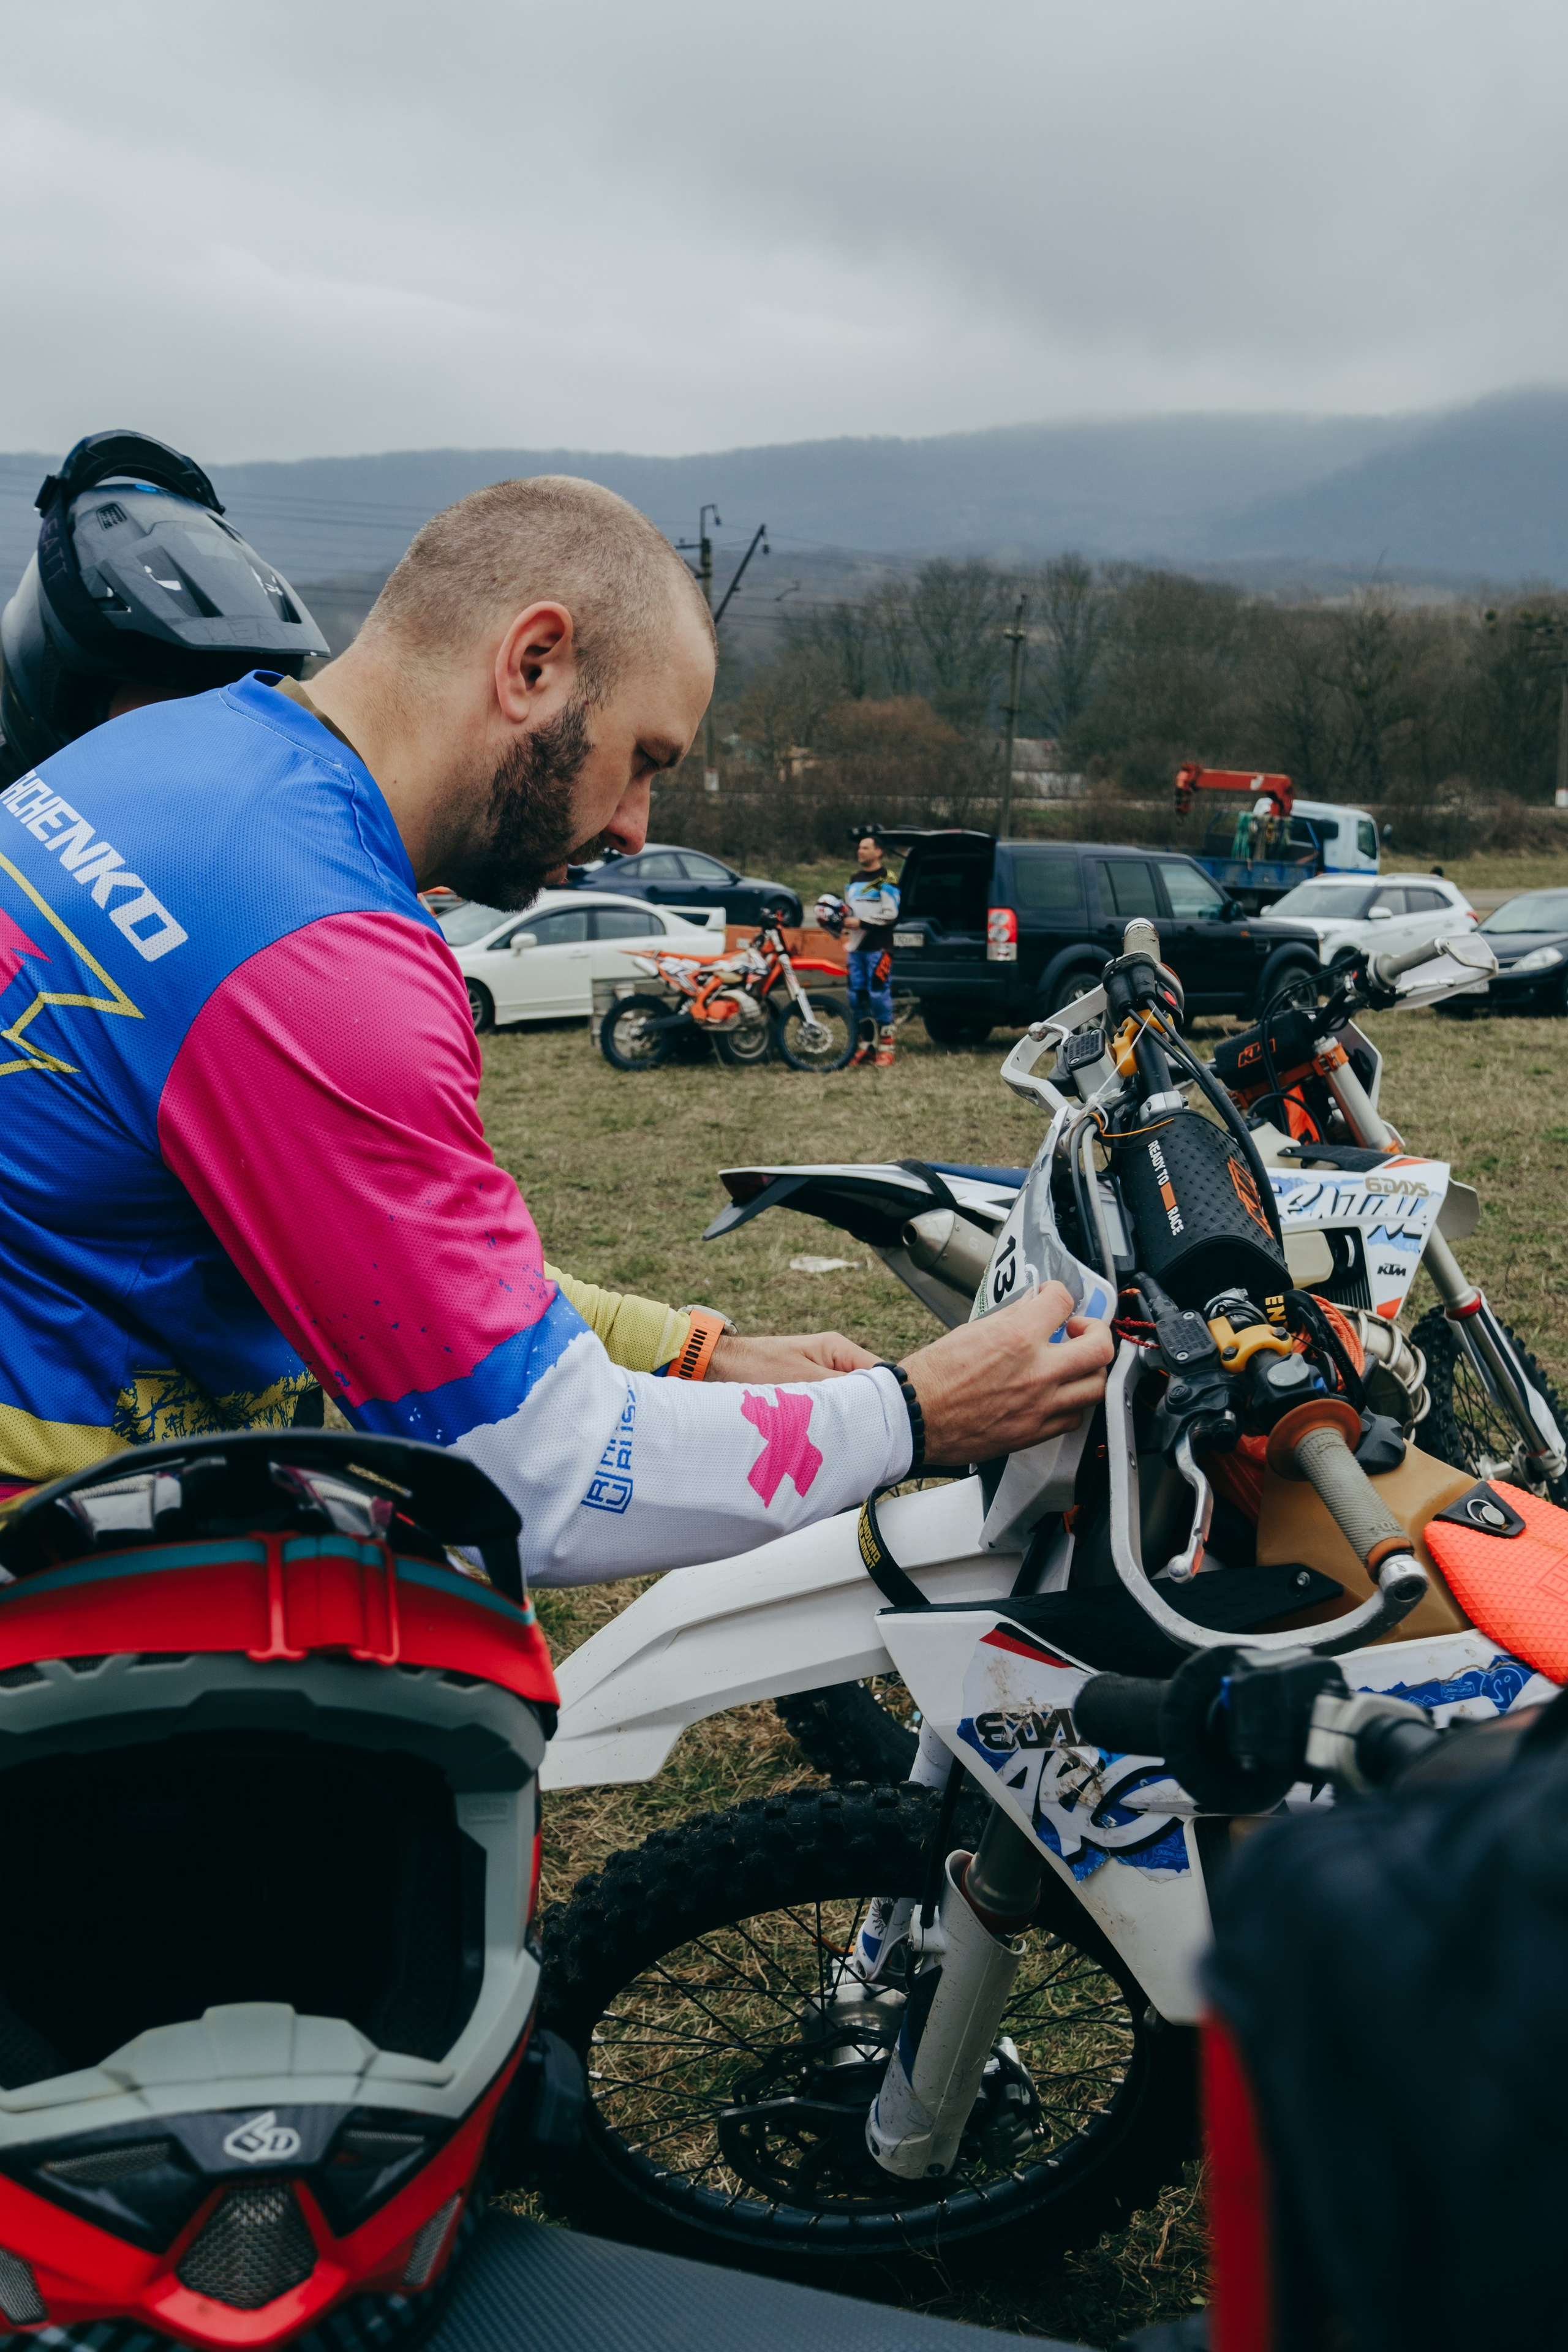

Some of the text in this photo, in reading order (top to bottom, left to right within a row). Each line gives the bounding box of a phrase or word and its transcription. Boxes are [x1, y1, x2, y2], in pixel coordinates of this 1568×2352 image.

[1147, 1139, 1184, 1236] READY TO RACE
[993, 1234, 1016, 1304] 13
[1377, 1263, 1406, 1276] KTM
[1265, 1295, 1287, 1322] EN
